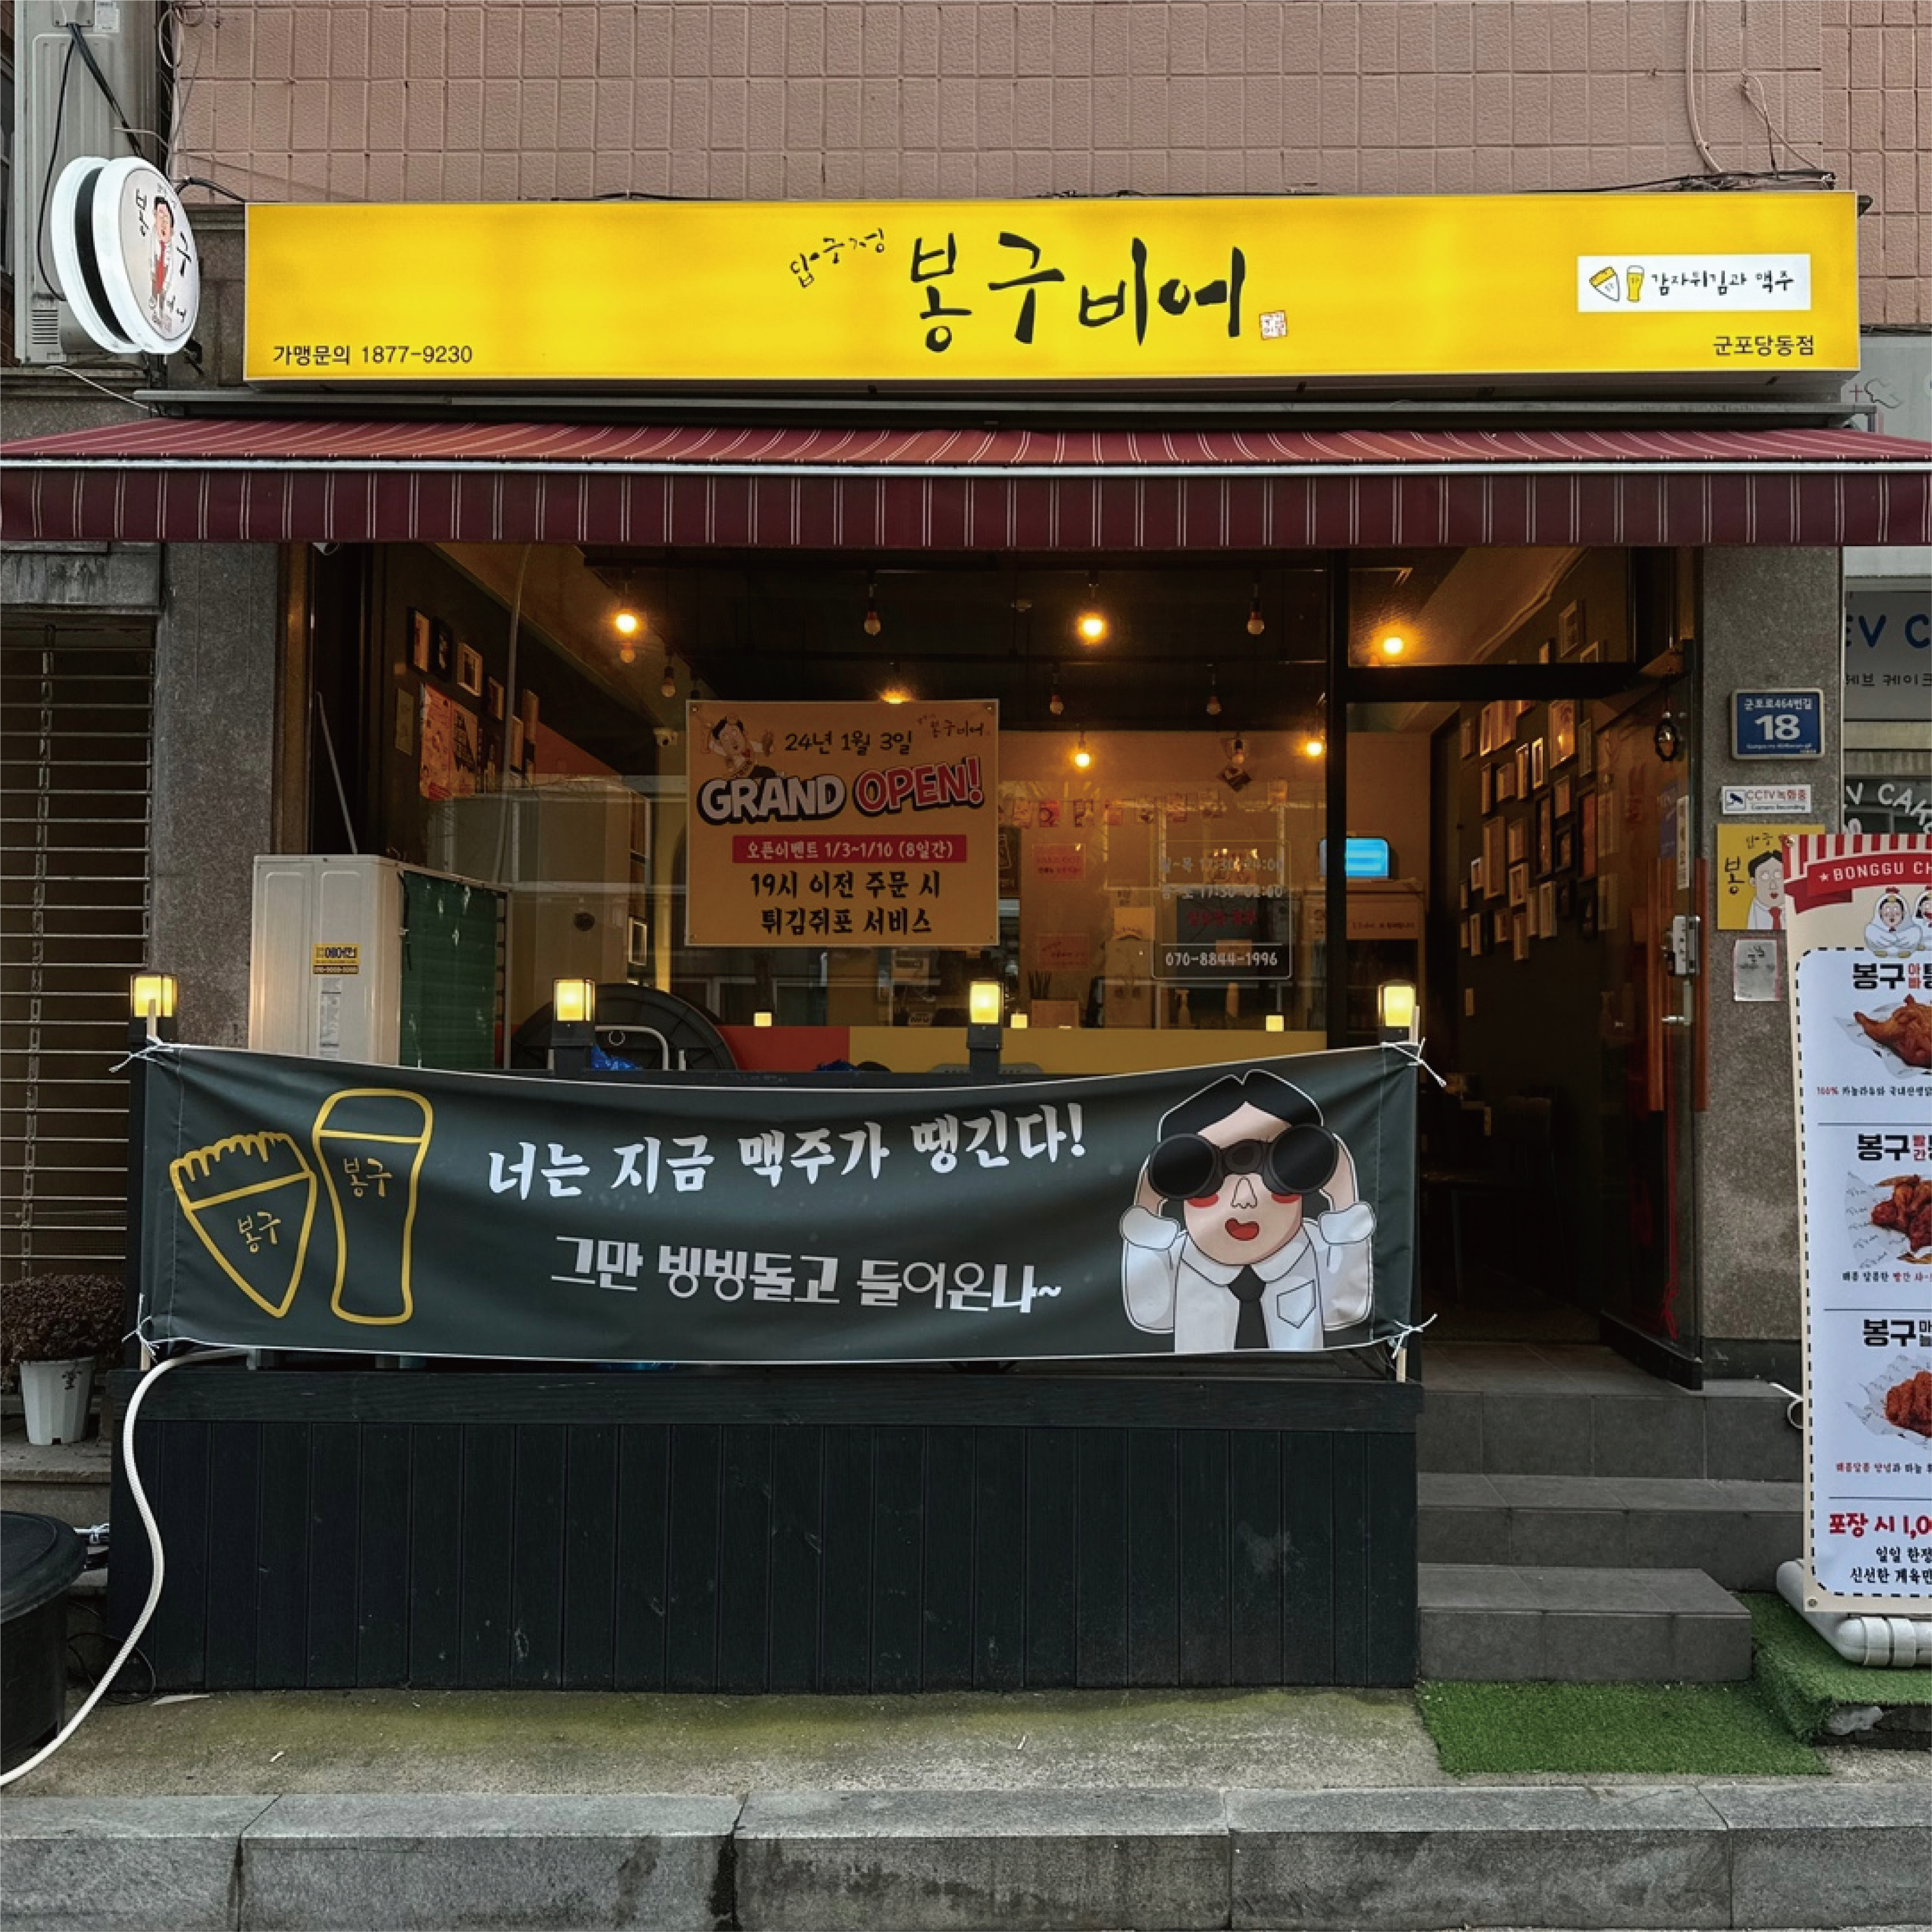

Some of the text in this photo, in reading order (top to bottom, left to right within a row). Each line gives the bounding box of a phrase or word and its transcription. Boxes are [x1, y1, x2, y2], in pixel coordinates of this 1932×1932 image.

[910, 232, 1246, 353] 봉구비어
[273, 345, 473, 366] 가맹문의 1877-9230
[1713, 335, 1814, 357] 군포당동점
[1754, 714, 1800, 740] 18
[785, 730, 913, 756] 24년 1월 3일
[698, 755, 984, 825] GRAND OPEN!
[747, 840, 953, 859] 오픈이벤트 1/3~1/10 (8일간)
[751, 871, 940, 898] 19시 이전 주문 시
[1724, 856, 1745, 896] 봉
[1833, 861, 1904, 882] BONGGU
[761, 907, 932, 935] 튀김쥐포 서비스
[1166, 952, 1278, 965] 070-8844-1996
[1852, 963, 1906, 990] 봉구
[488, 1101, 1085, 1200] 너는 지금 맥주가 땡긴다!
[1857, 1133, 1911, 1162] 봉구
[343, 1157, 392, 1197] 봉구
[237, 1211, 281, 1253] 봉구
[551, 1235, 1062, 1313] 그만 빙빙돌고 들어온나~
[1862, 1319, 1917, 1347] 봉구
[1829, 1513, 1932, 1541] 포장 시 1,0
[1875, 1545, 1901, 1563] 일일
[1850, 1567, 1891, 1584] 신선한
